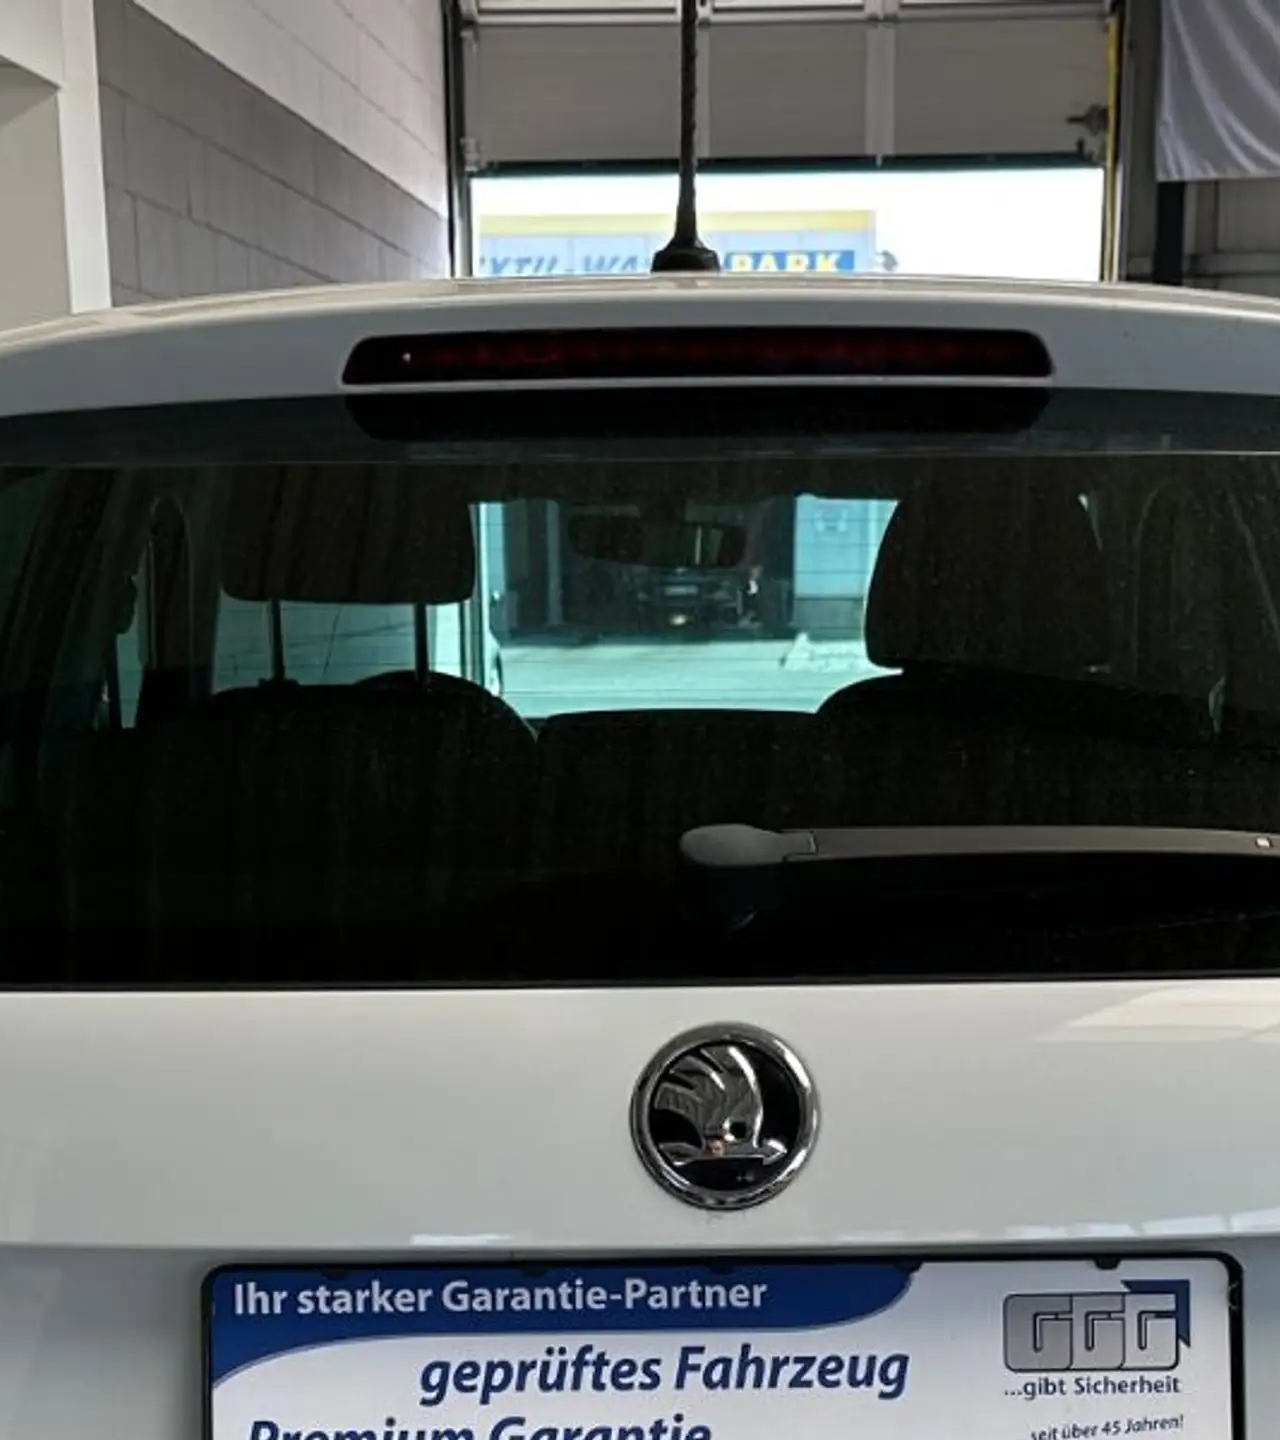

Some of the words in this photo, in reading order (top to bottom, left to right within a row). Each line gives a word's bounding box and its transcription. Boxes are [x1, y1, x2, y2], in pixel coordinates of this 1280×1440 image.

[234, 1281, 285, 1316] Ihr
[297, 1280, 433, 1315] starker
[442, 1278, 768, 1312] Garantie-Partner
[420, 1344, 662, 1406] geprüftes
[674, 1345, 911, 1401] Fahrzeug
[1074, 1374, 1183, 1396] Sicherheit
[1062, 1424, 1098, 1440] über
[1101, 1420, 1121, 1436] 45
[1124, 1413, 1185, 1435] Jahren!
